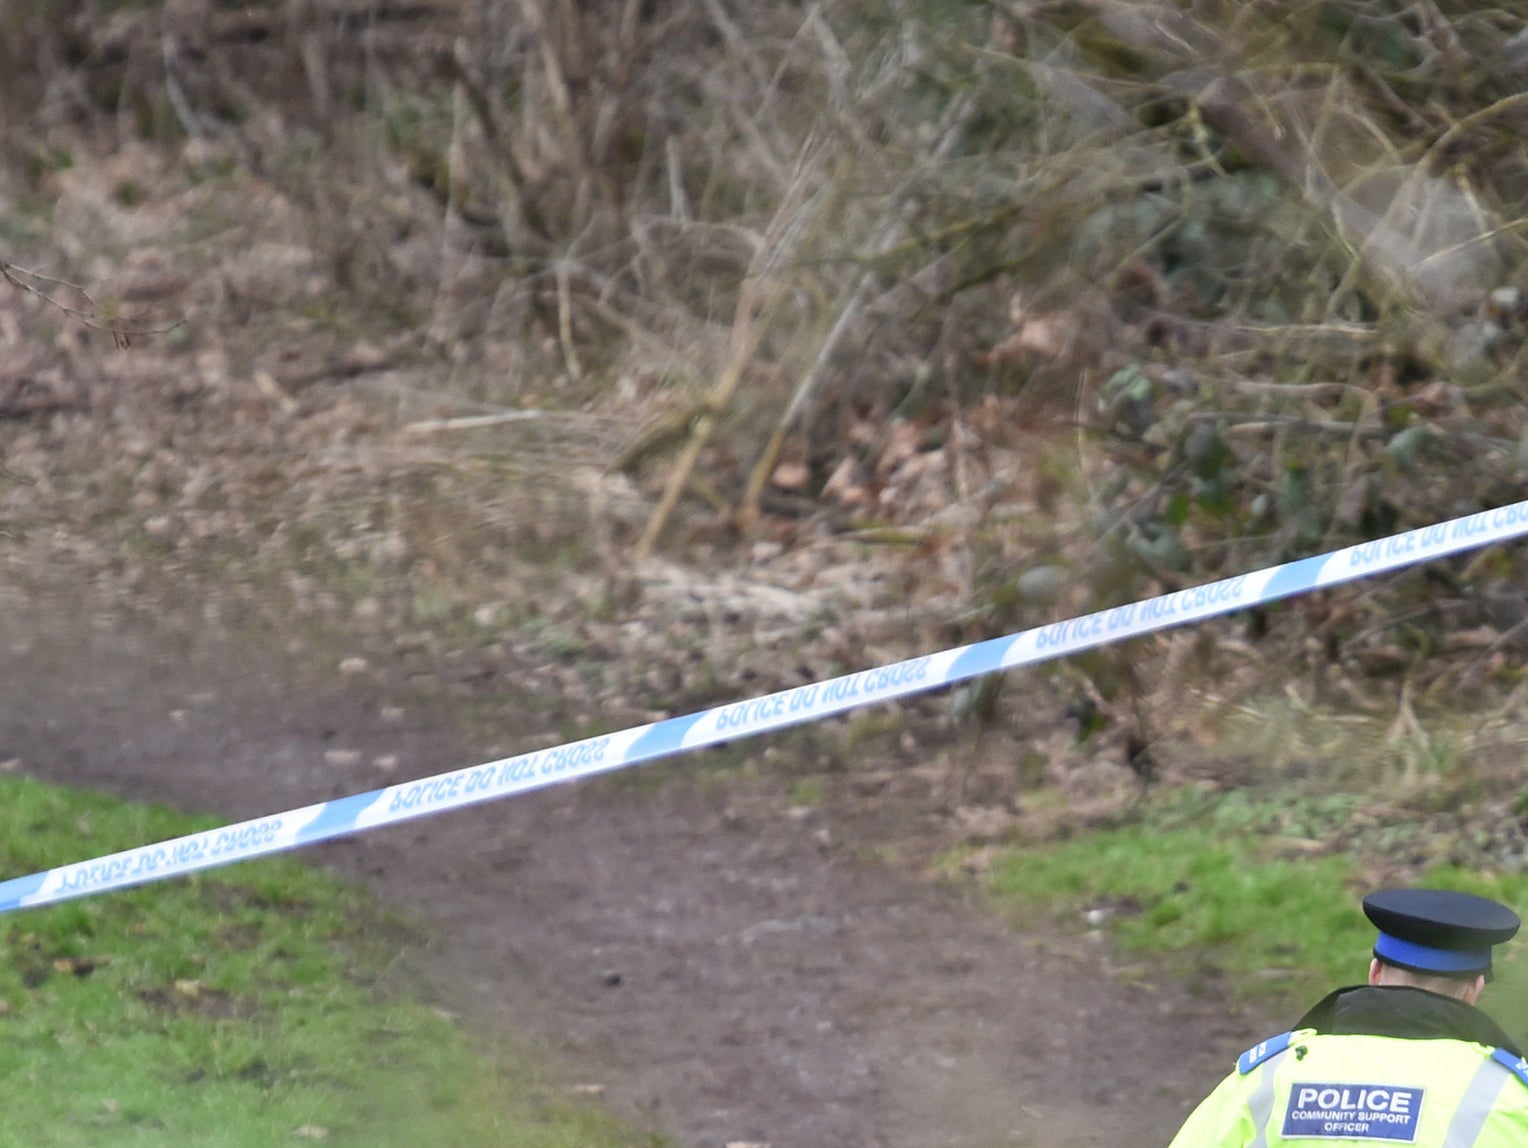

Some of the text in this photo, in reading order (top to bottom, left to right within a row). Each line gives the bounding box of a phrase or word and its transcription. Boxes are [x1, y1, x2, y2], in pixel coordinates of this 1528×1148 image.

[1297, 1088, 1412, 1113] POLICE
[1292, 1110, 1411, 1124] COMMUNITY SUPPORT
[1324, 1122, 1370, 1132] OFFICER
